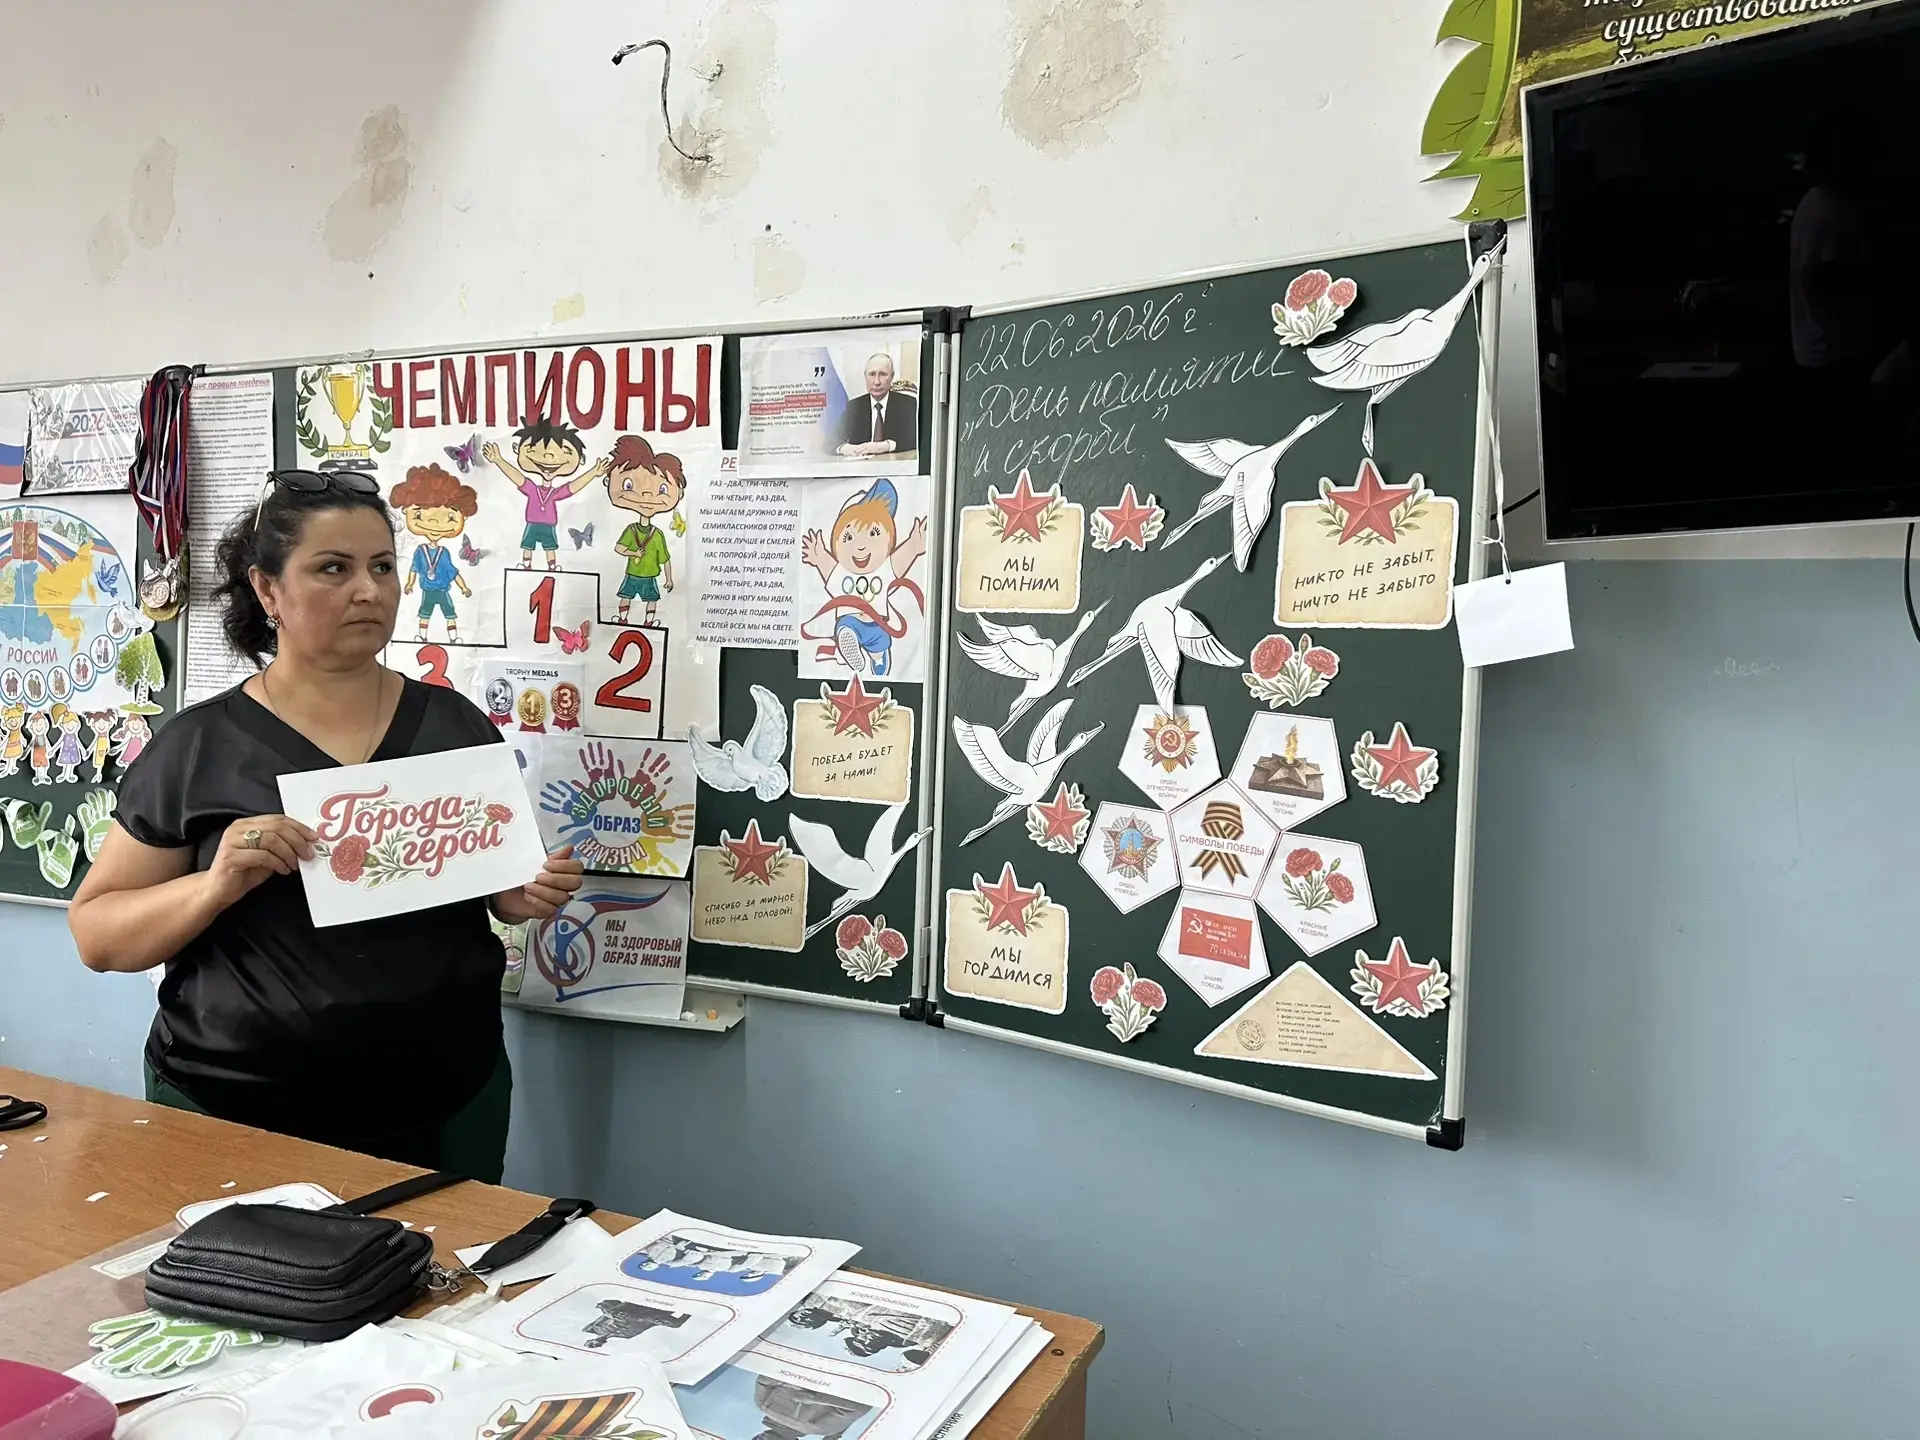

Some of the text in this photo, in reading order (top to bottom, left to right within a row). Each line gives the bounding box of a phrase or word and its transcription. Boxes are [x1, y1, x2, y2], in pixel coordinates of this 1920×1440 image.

[373, 344, 711, 433] ЧЕМПИОНЫ
[1079, 348, 1296, 413] памяти
[756, 495, 787, 503] РАЗ-ДВА,
[746, 509, 776, 517] ДРУЖНО
[766, 537, 795, 545] СМЕЛЕЙ
[719, 551, 757, 559] ПОПРОБУЙ
[1003, 556, 1034, 572] МЫ
[743, 566, 785, 574] ТРИ-ЧЕТЫРЕ,
[1295, 549, 1434, 589] НИКТО НЕ ЗАБЫТ,
[710, 580, 785, 589] ТРИ-ЧЕТЫРЕ, РАЗ-ДВА,
[979, 575, 1059, 592] ПОМНИМ
[1292, 573, 1436, 612] НИЧТО НЕ ЗАБЫТО
[701, 594, 730, 602] ДРУЖНО
[528, 575, 556, 644] 1
[749, 609, 789, 617] ПОДВЕДЕМ.
[701, 621, 728, 629] ВЕСЕЛЕЙ
[778, 638, 799, 646] ДЕТИ!
[7, 647, 58, 665] РОССИИ
[505, 667, 559, 678] TROPHY MEDALS
[594, 629, 653, 713] 2
[811, 745, 893, 767] ПОБЕДА БУДЕТ
[824, 766, 876, 783] ЗА НАМИ!
[317, 783, 476, 845] Города-
[593, 814, 641, 833] ОБРАЗ
[402, 824, 504, 877] герои
[577, 836, 648, 865] ЖИЗНИ
[1179, 834, 1265, 856] СИМВОЛЫ ПОБЕДЫ
[705, 893, 795, 913] СПАСИБО ЗА МИРНОЕ
[605, 919, 626, 932] МЫ
[705, 907, 793, 926] НЕБО НАД ГОЛОВОЙ!
[604, 936, 682, 953] ЗА ЗДОРОВЫЙ
[603, 951, 682, 969] ОБРАЗ ЖИЗНИ
[991, 947, 1021, 963] МЫ
[964, 960, 1052, 990] ГОРДИМСЯ
[645, 1297, 675, 1307] МИНСК
[849, 1291, 920, 1310] НОВОРОССИЙСК
[779, 1369, 832, 1388] МУРМАНСК
